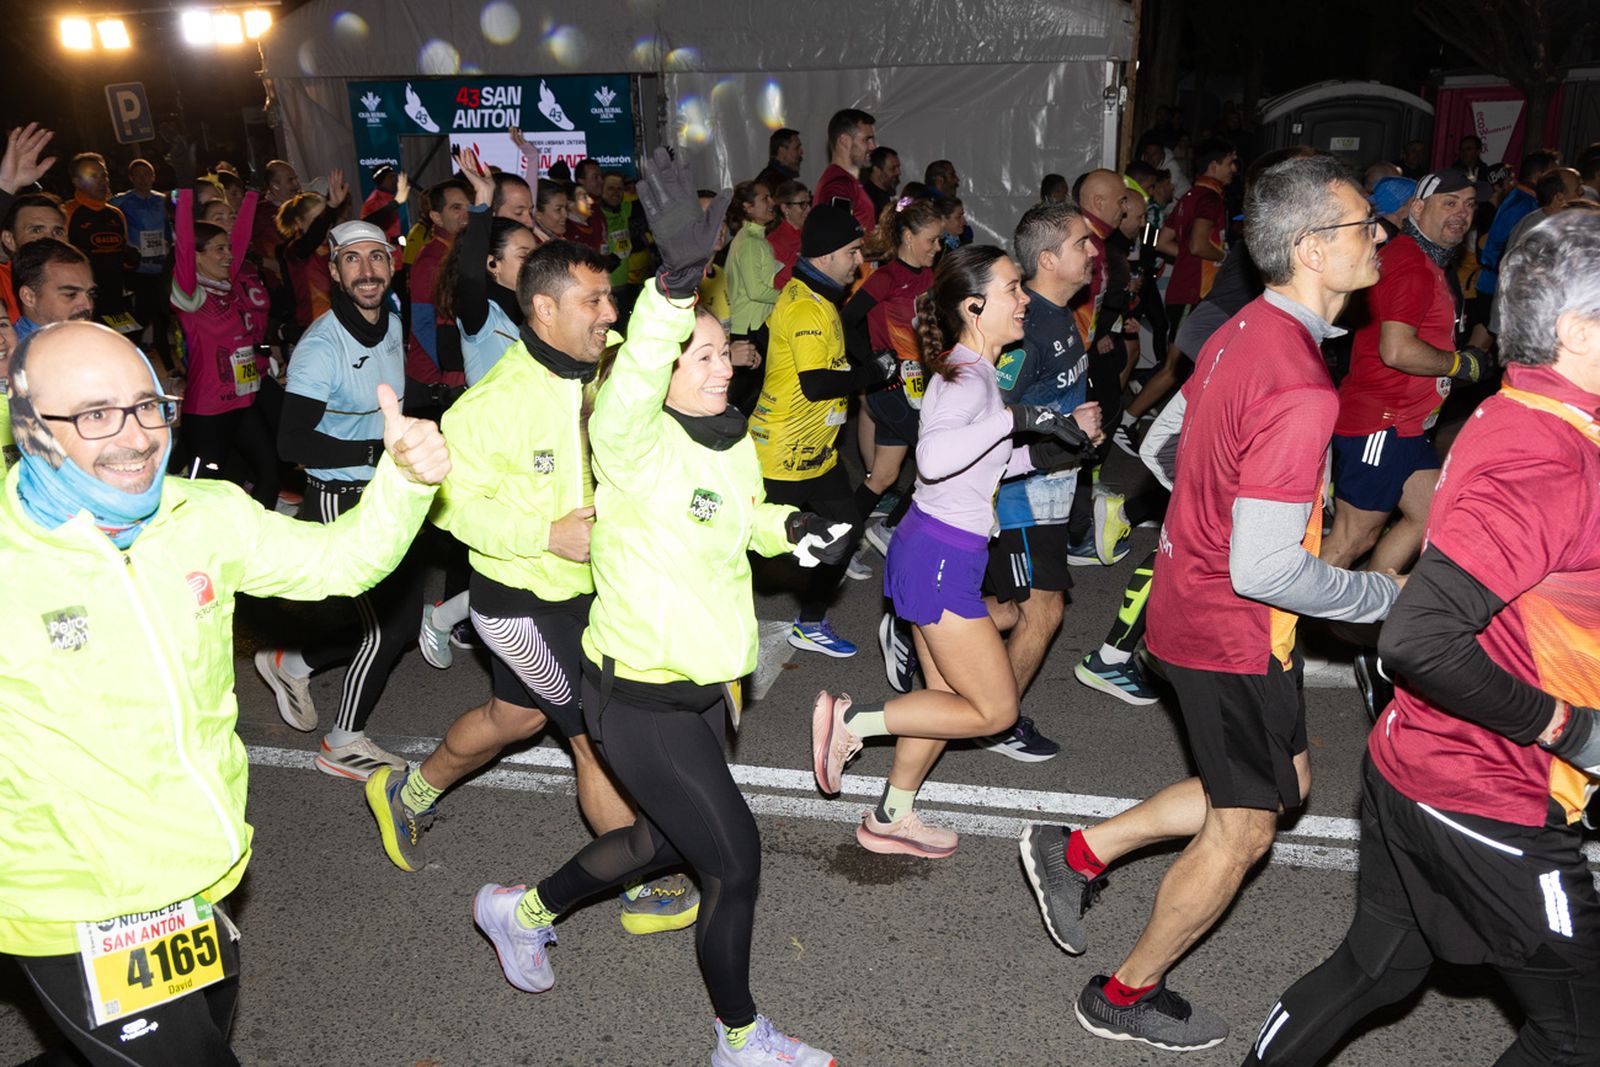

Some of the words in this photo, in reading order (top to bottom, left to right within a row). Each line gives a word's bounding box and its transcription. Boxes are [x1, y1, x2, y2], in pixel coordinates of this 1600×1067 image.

[456, 86, 480, 108] 43
[481, 86, 522, 106] SAN
[115, 90, 141, 136] P
[415, 111, 428, 125] 43
[453, 103, 520, 128] ANTÓN
[550, 108, 562, 122] 43
[521, 153, 551, 169] SN
[102, 930, 136, 953] SAN
[140, 912, 186, 943] ANTÓN
[127, 924, 218, 990] 4165
[168, 978, 193, 995] David
